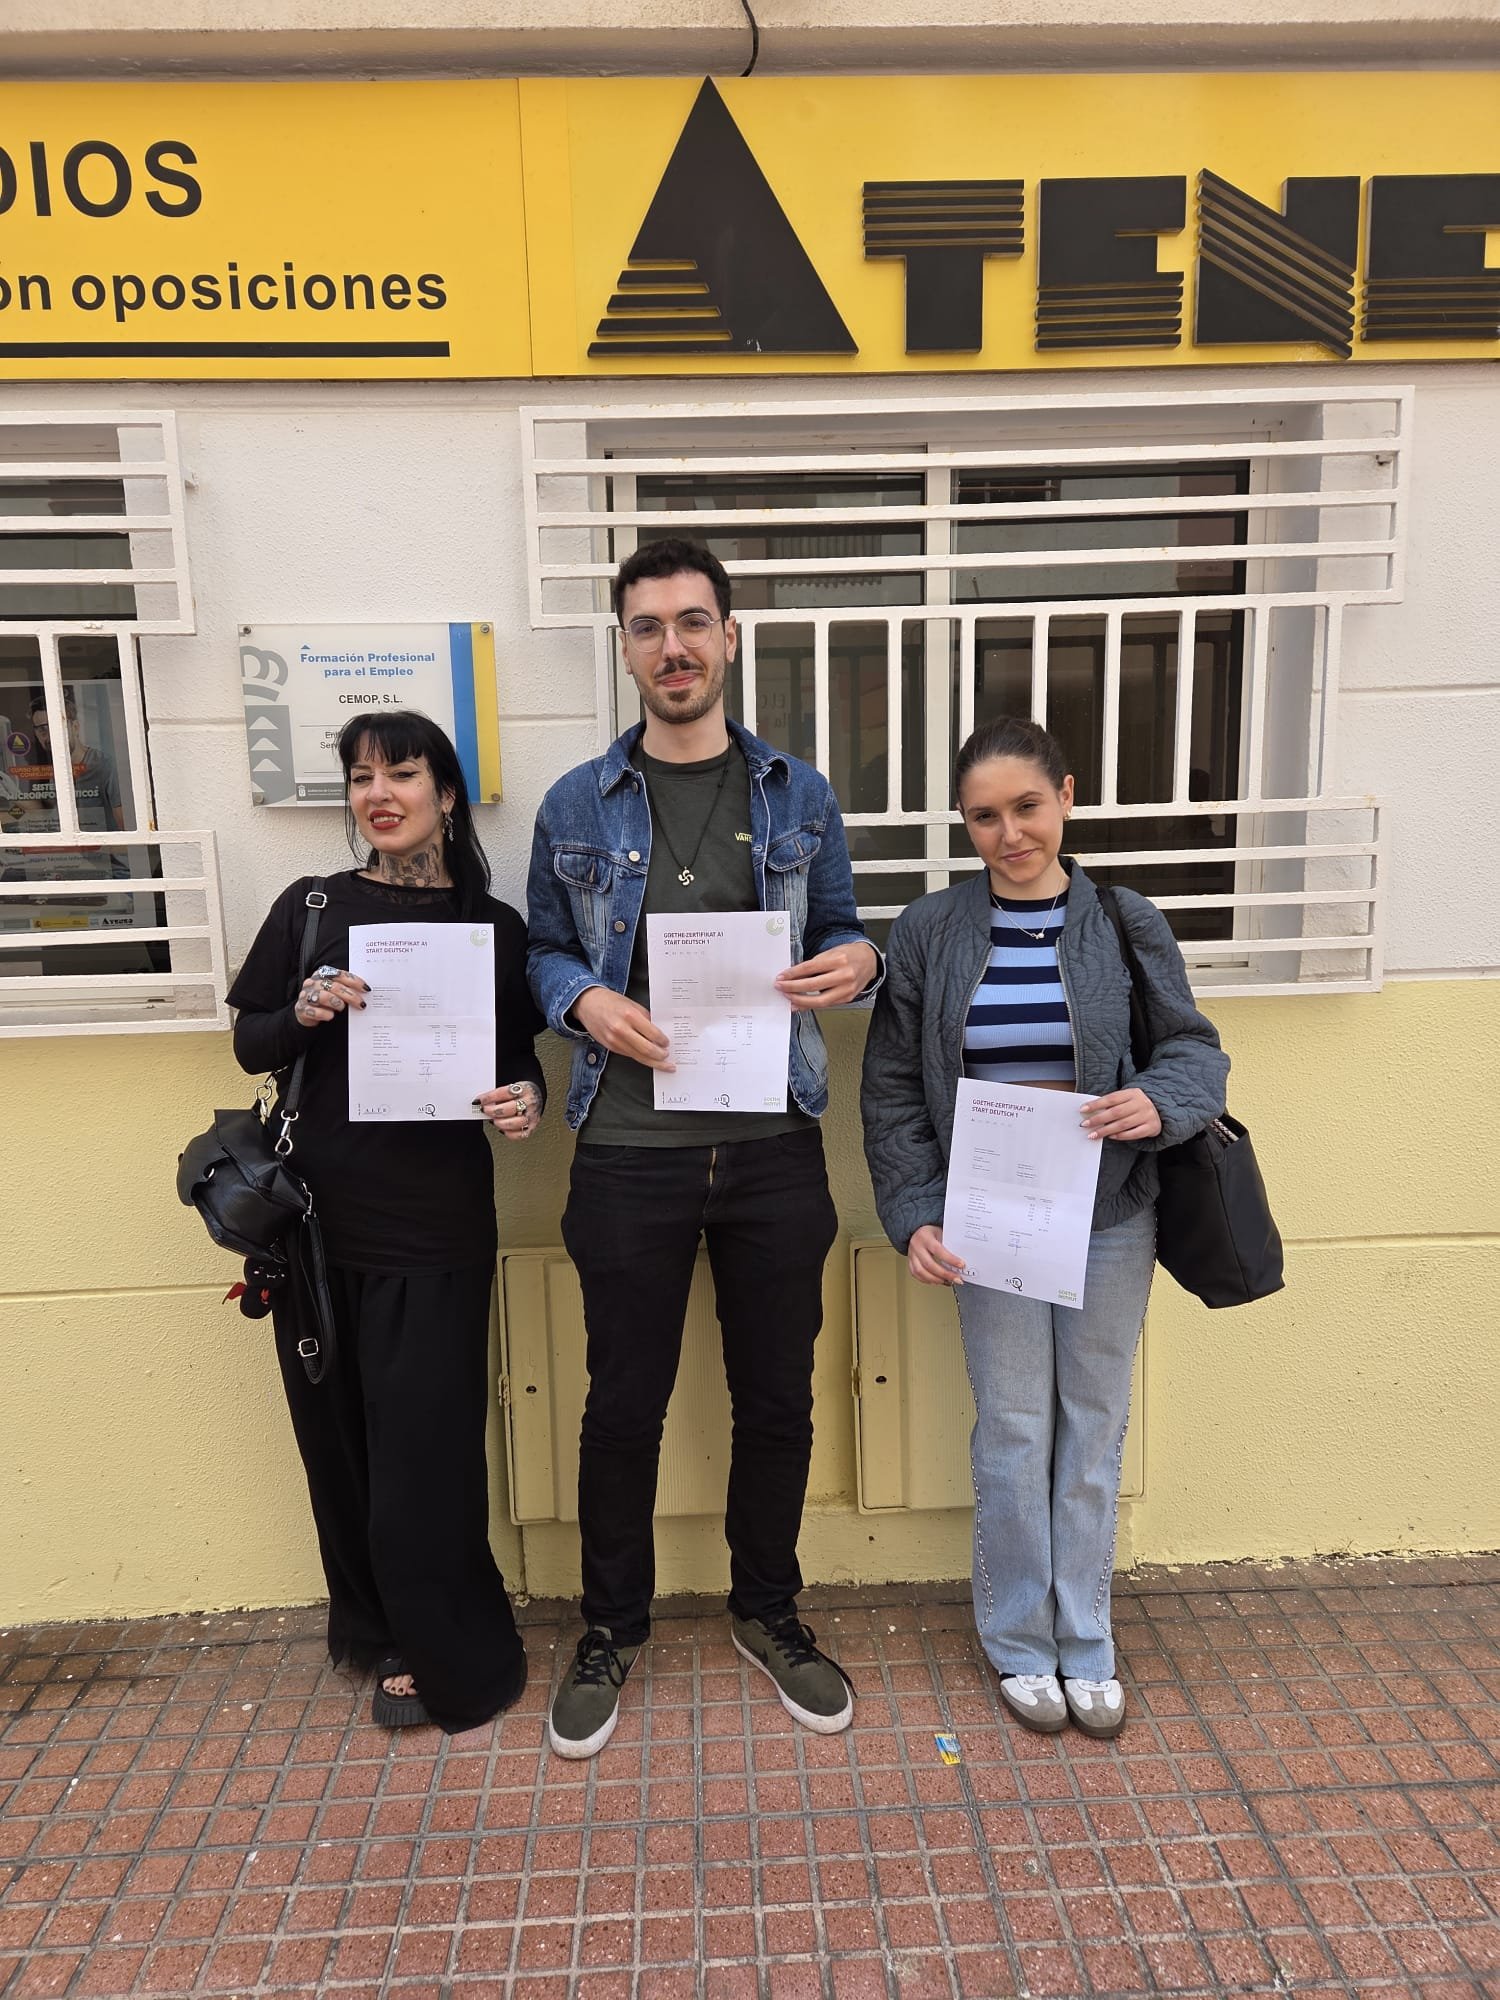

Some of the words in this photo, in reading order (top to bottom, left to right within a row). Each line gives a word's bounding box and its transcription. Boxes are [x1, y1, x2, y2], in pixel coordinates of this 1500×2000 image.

[72, 262, 447, 322] oposiciones
[300, 652, 364, 663] Formación
[368, 652, 435, 663] Profesional
[324, 668, 351, 678] para
[356, 667, 366, 676] el
[370, 667, 413, 678] Empleo
[338, 694, 380, 705] CEMOP,
[383, 694, 403, 704] S.L.
